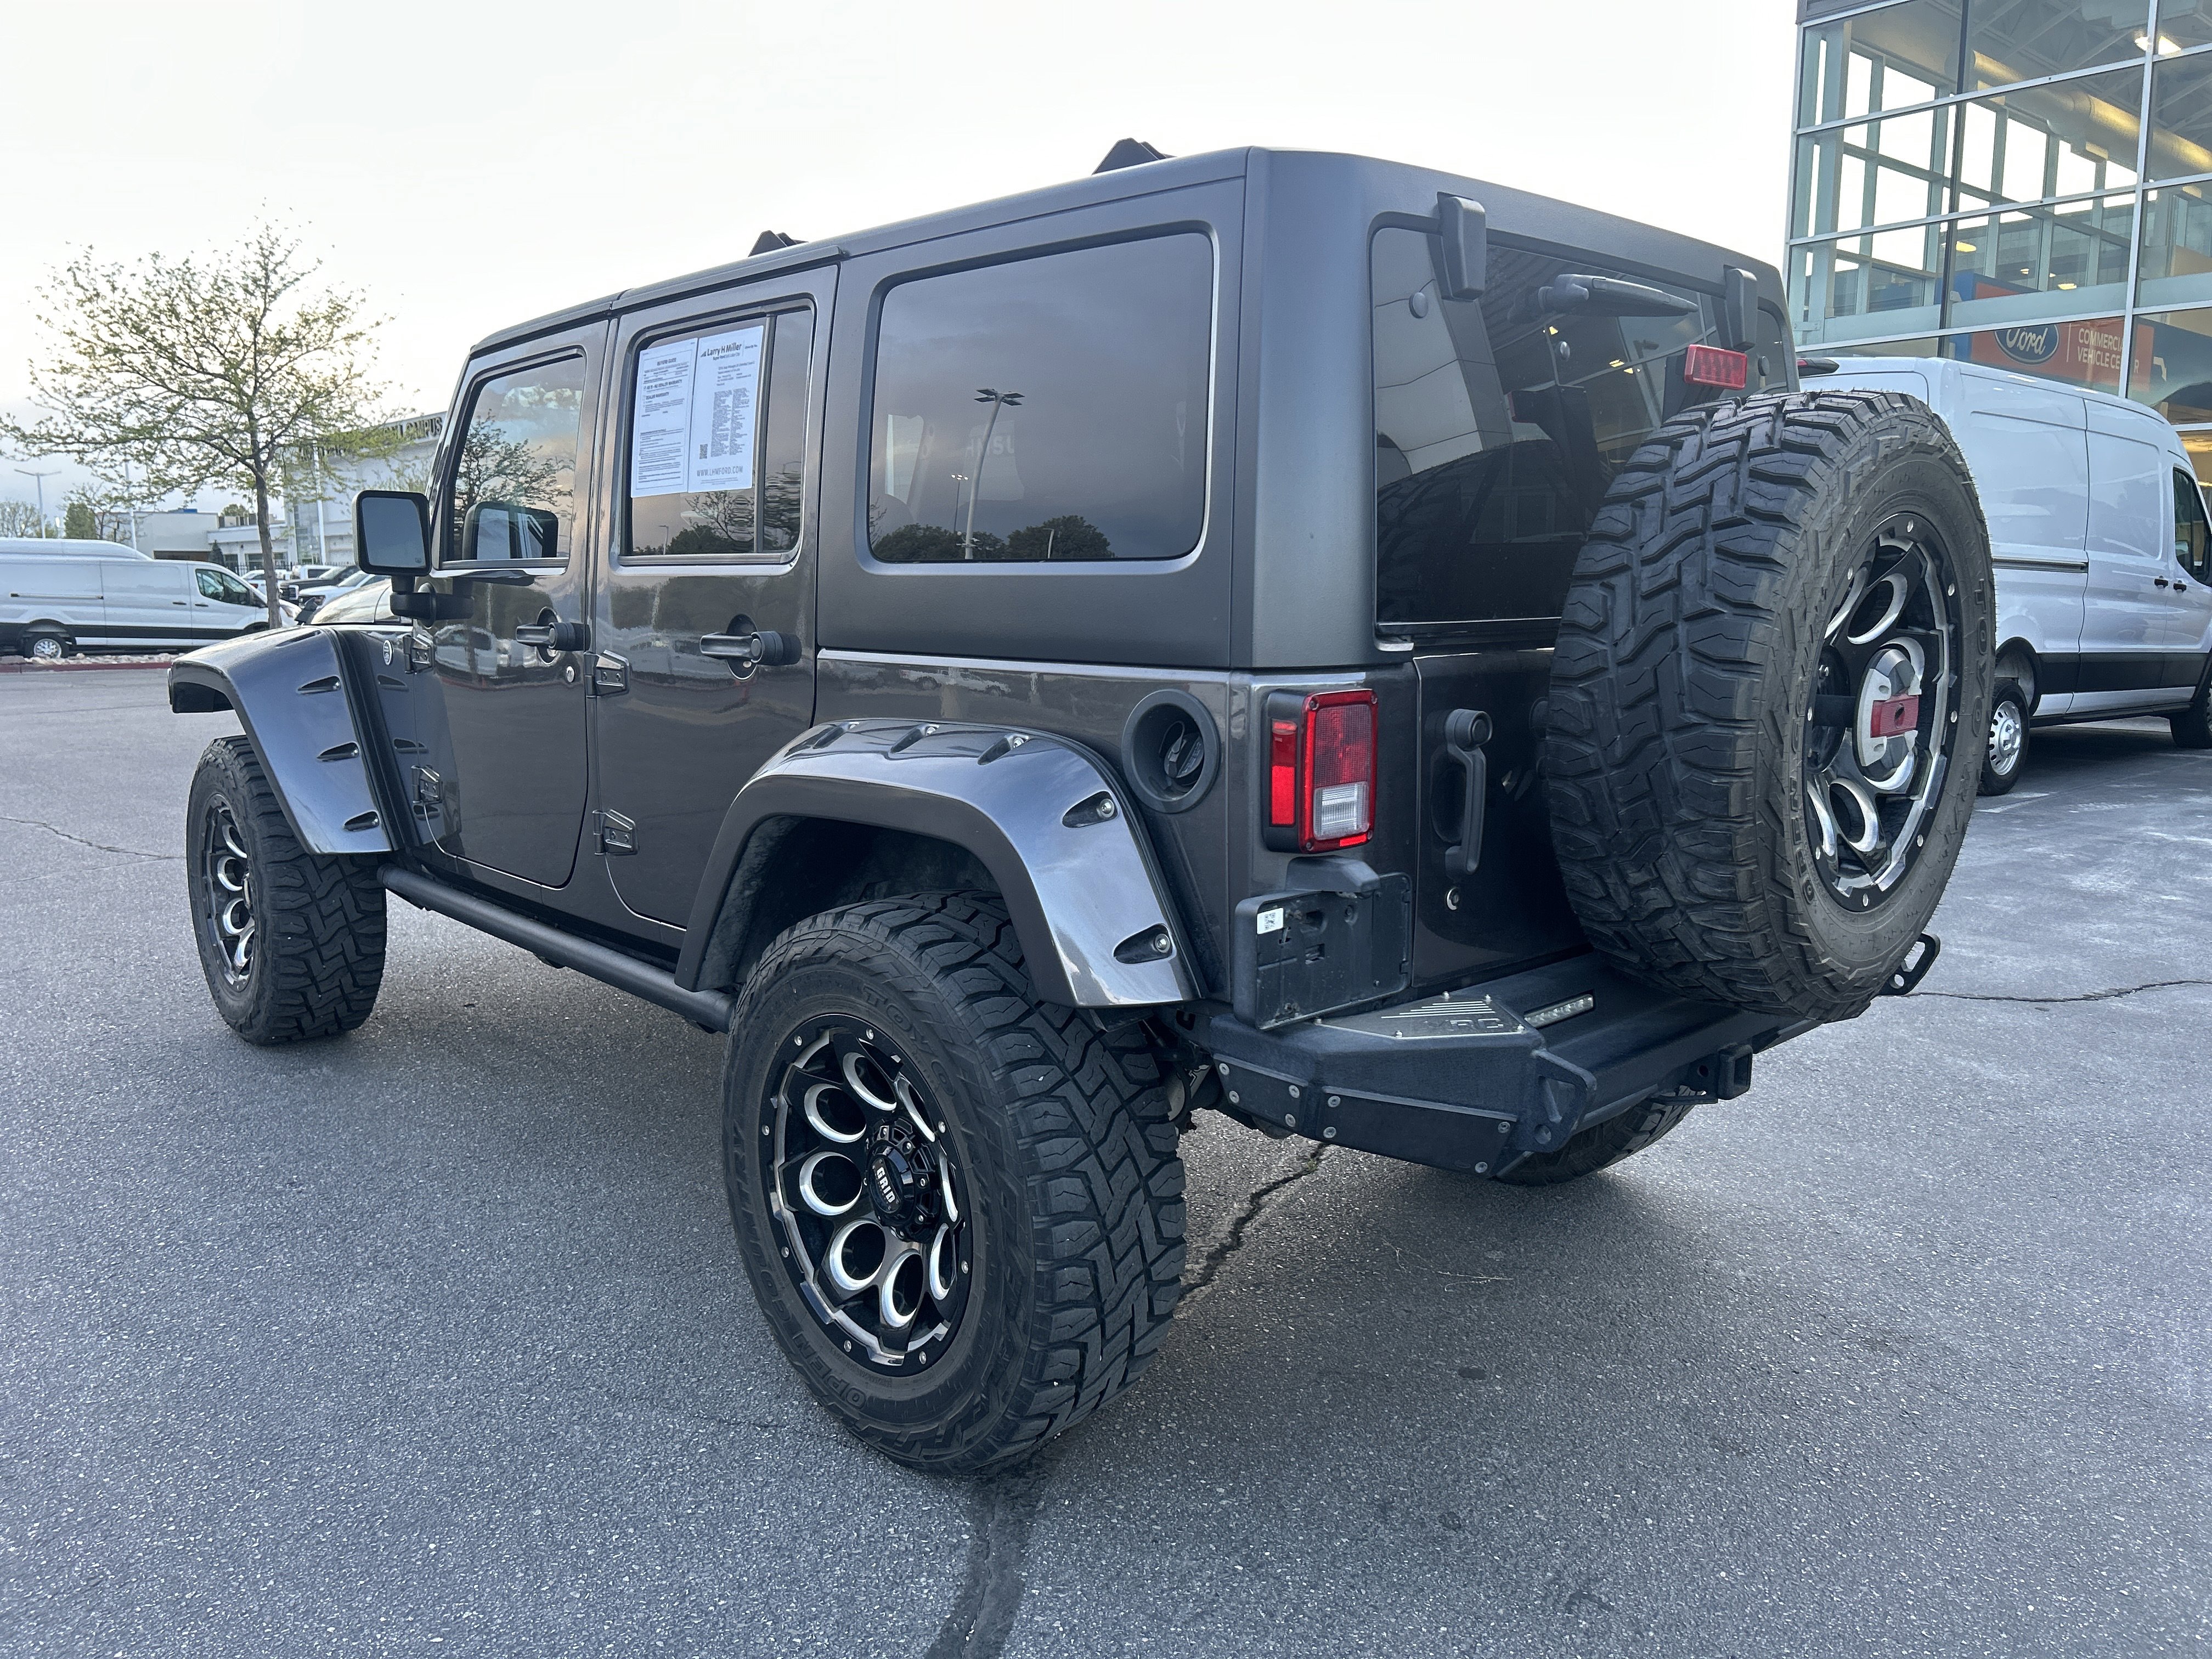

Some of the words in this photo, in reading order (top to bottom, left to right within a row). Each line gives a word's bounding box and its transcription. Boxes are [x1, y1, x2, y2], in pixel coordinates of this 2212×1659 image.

[726, 342, 742, 353] Miller
[2078, 328, 2123, 351] COMMERCI
[2077, 346, 2109, 368] VEHICLE
[697, 466, 743, 476] WWW.LHMFORD.COM
[1972, 578, 1987, 737] TOYO
[862, 982, 956, 1098] TOYO
[876, 1166, 896, 1203] GRID
[792, 1330, 867, 1409] OPEN
